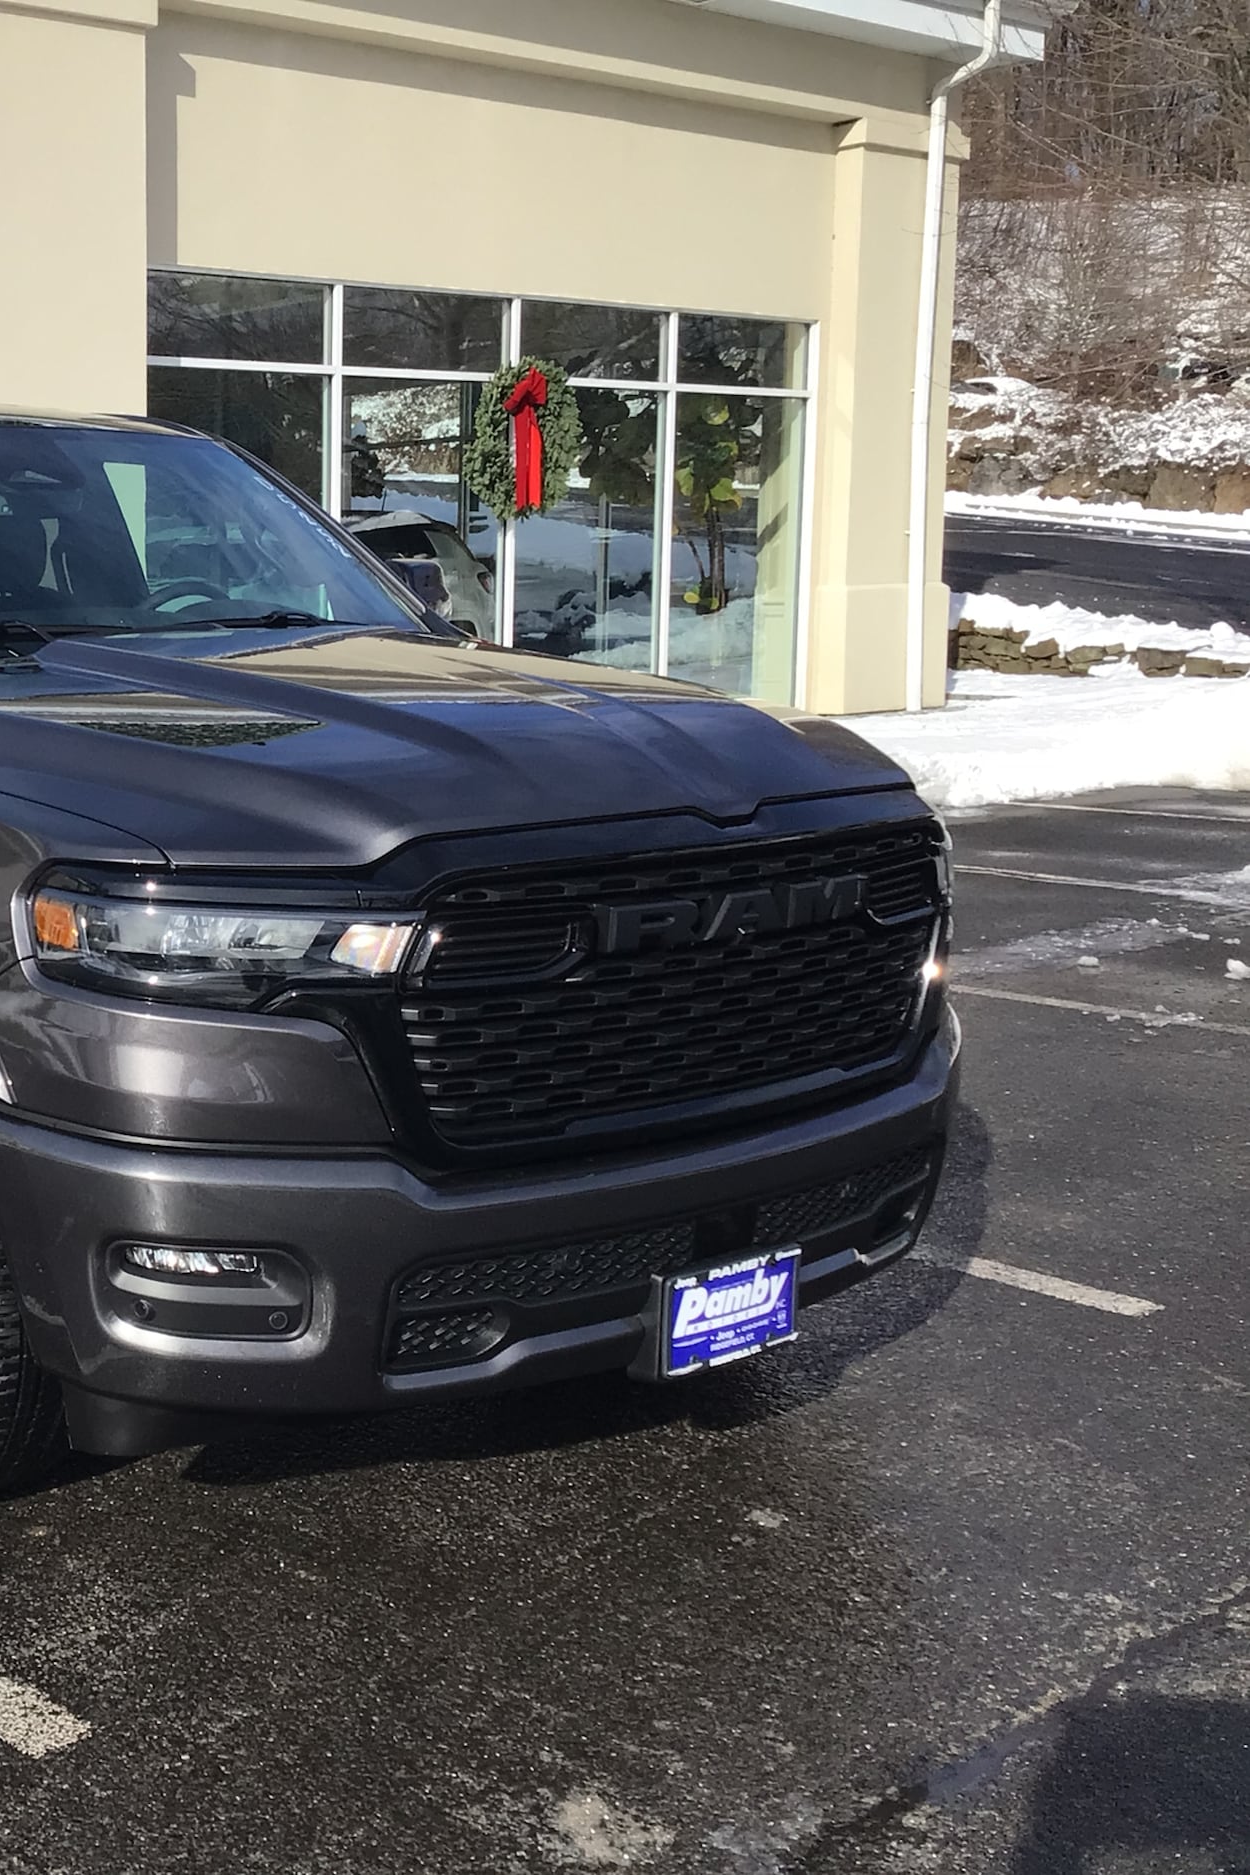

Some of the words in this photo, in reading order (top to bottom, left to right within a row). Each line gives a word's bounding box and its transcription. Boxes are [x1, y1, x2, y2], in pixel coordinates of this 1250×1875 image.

[602, 874, 868, 953] RAM
[708, 1254, 771, 1281] PAMBY
[672, 1268, 789, 1339] Pamby
